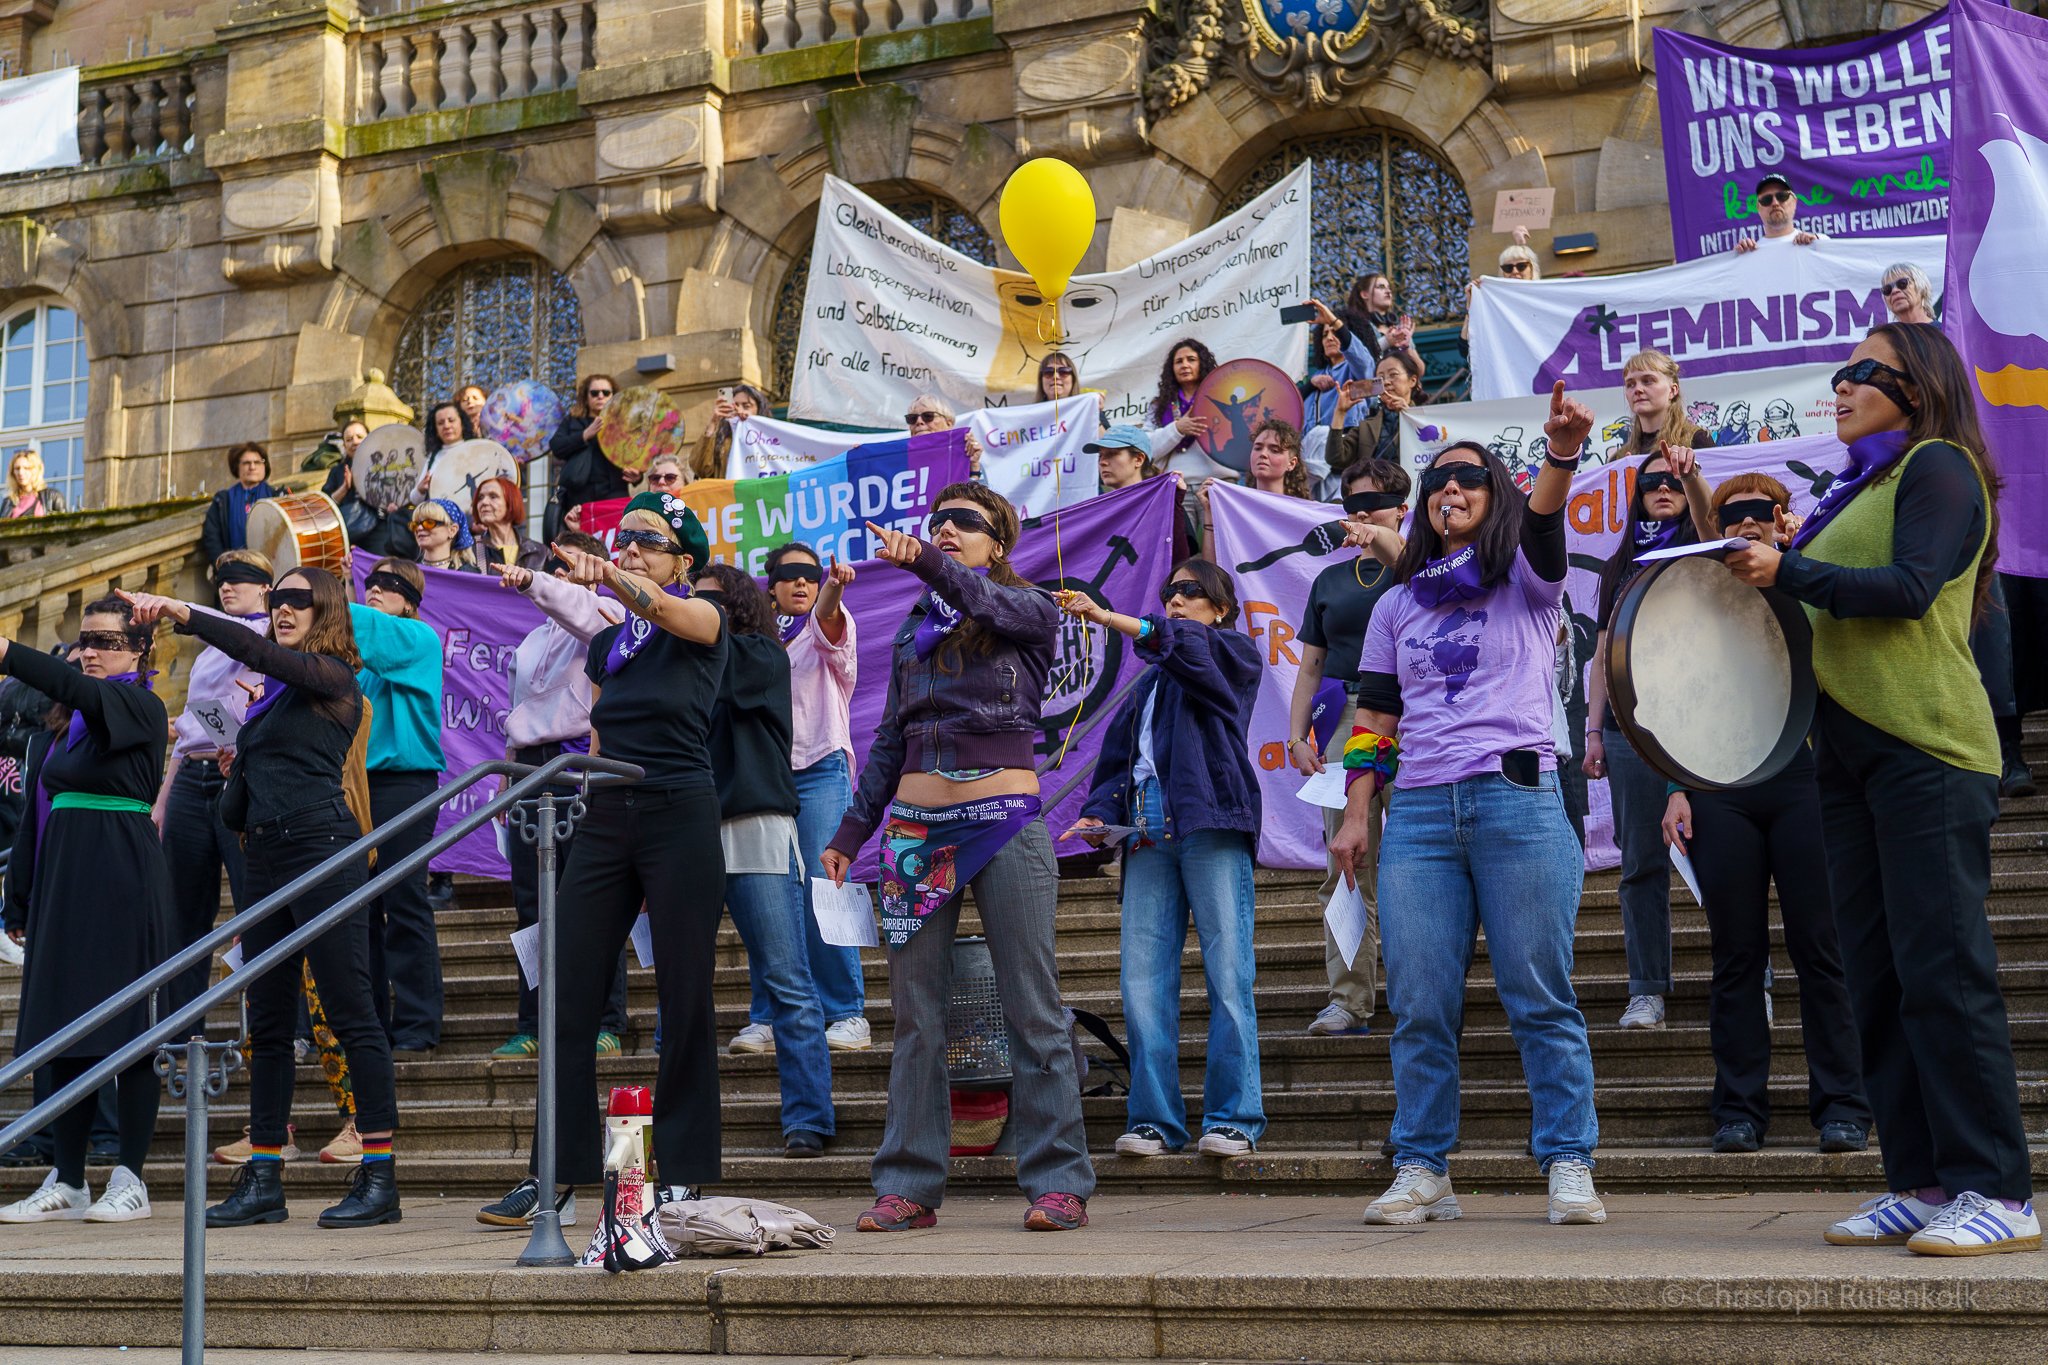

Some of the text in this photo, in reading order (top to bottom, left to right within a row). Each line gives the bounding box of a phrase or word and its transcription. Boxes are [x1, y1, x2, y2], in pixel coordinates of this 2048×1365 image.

[1682, 24, 1951, 113] WIR WOLLE
[1688, 88, 1951, 178] UNS LEBEN
[1850, 155, 1950, 199] meh
[1851, 195, 1950, 232] FEMINIZIDE
[1142, 294, 1170, 318] für
[1223, 300, 1238, 316] in
[817, 300, 979, 358] und Selbstbestimmung
[808, 347, 834, 370] für
[841, 351, 871, 373] alle
[745, 429, 781, 446] Ohne
[756, 467, 930, 538] WÜRDE!
[890, 931, 908, 944] 2025
